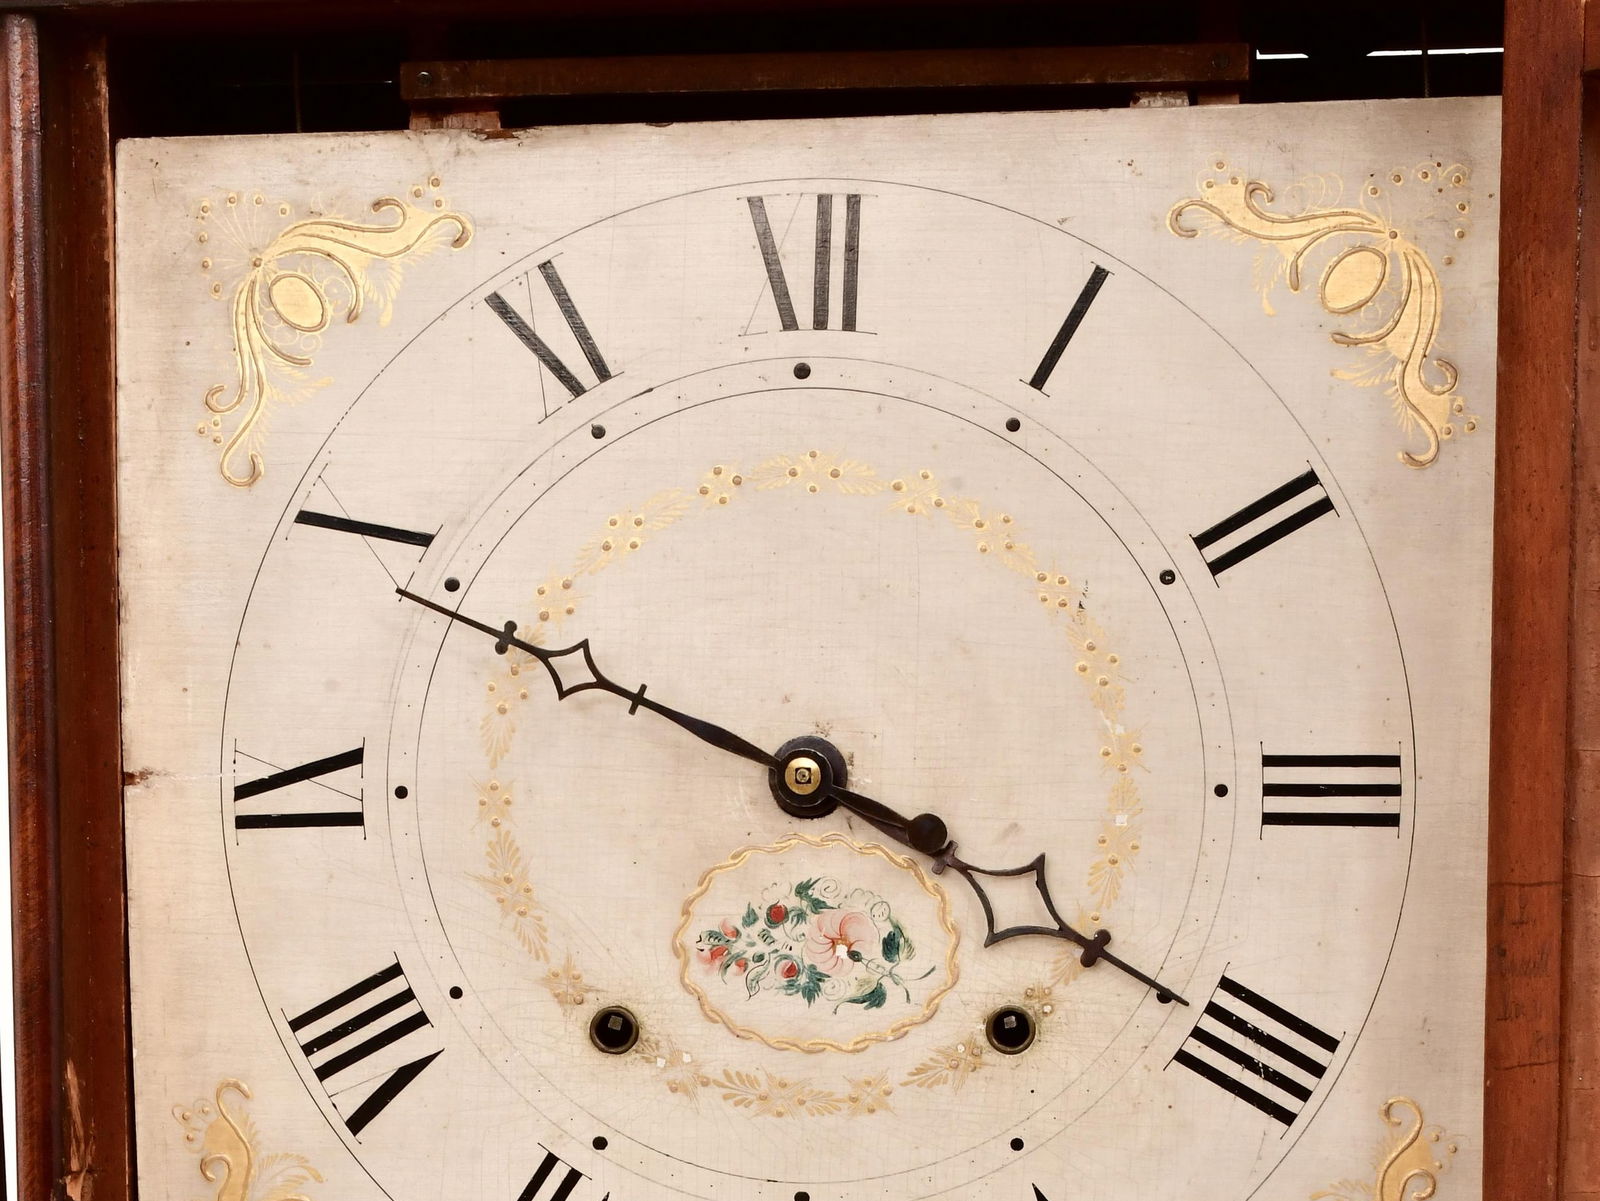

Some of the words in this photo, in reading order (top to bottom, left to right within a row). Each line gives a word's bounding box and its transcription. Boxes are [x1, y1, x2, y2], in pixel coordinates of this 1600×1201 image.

[738, 193, 877, 336] XII
[1020, 261, 1114, 397] I
[482, 252, 624, 424] XI
[286, 463, 443, 602] X
[1189, 460, 1340, 588] II
[233, 737, 366, 845] IX
[1260, 741, 1401, 840] III
[281, 951, 444, 1144] VIII
[1163, 962, 1345, 1140] IIII
